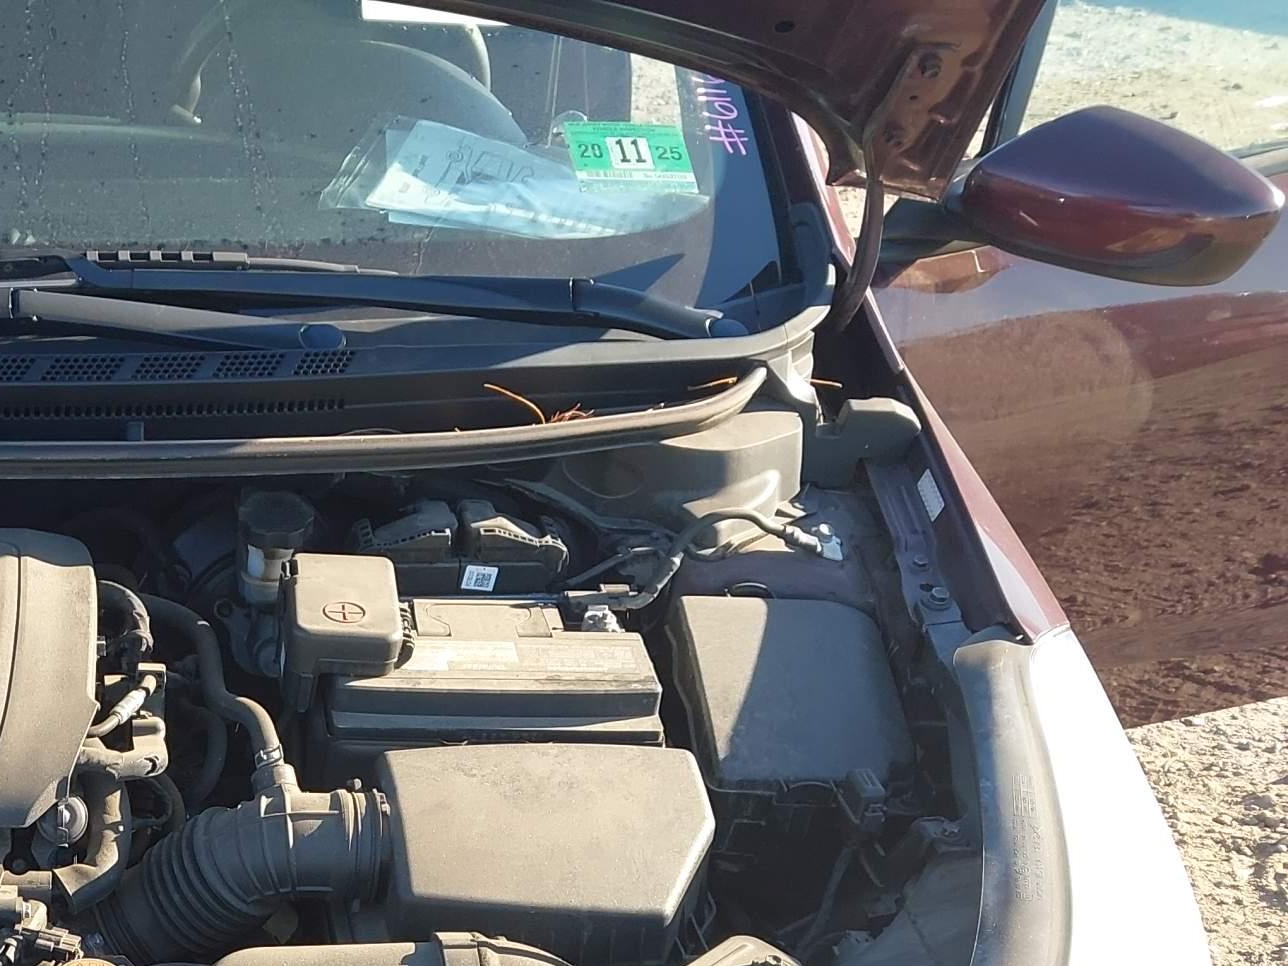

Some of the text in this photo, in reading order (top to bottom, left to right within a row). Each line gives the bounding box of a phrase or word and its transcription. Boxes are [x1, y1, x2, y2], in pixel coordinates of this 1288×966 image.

[577, 138, 683, 163] 20 11 25
